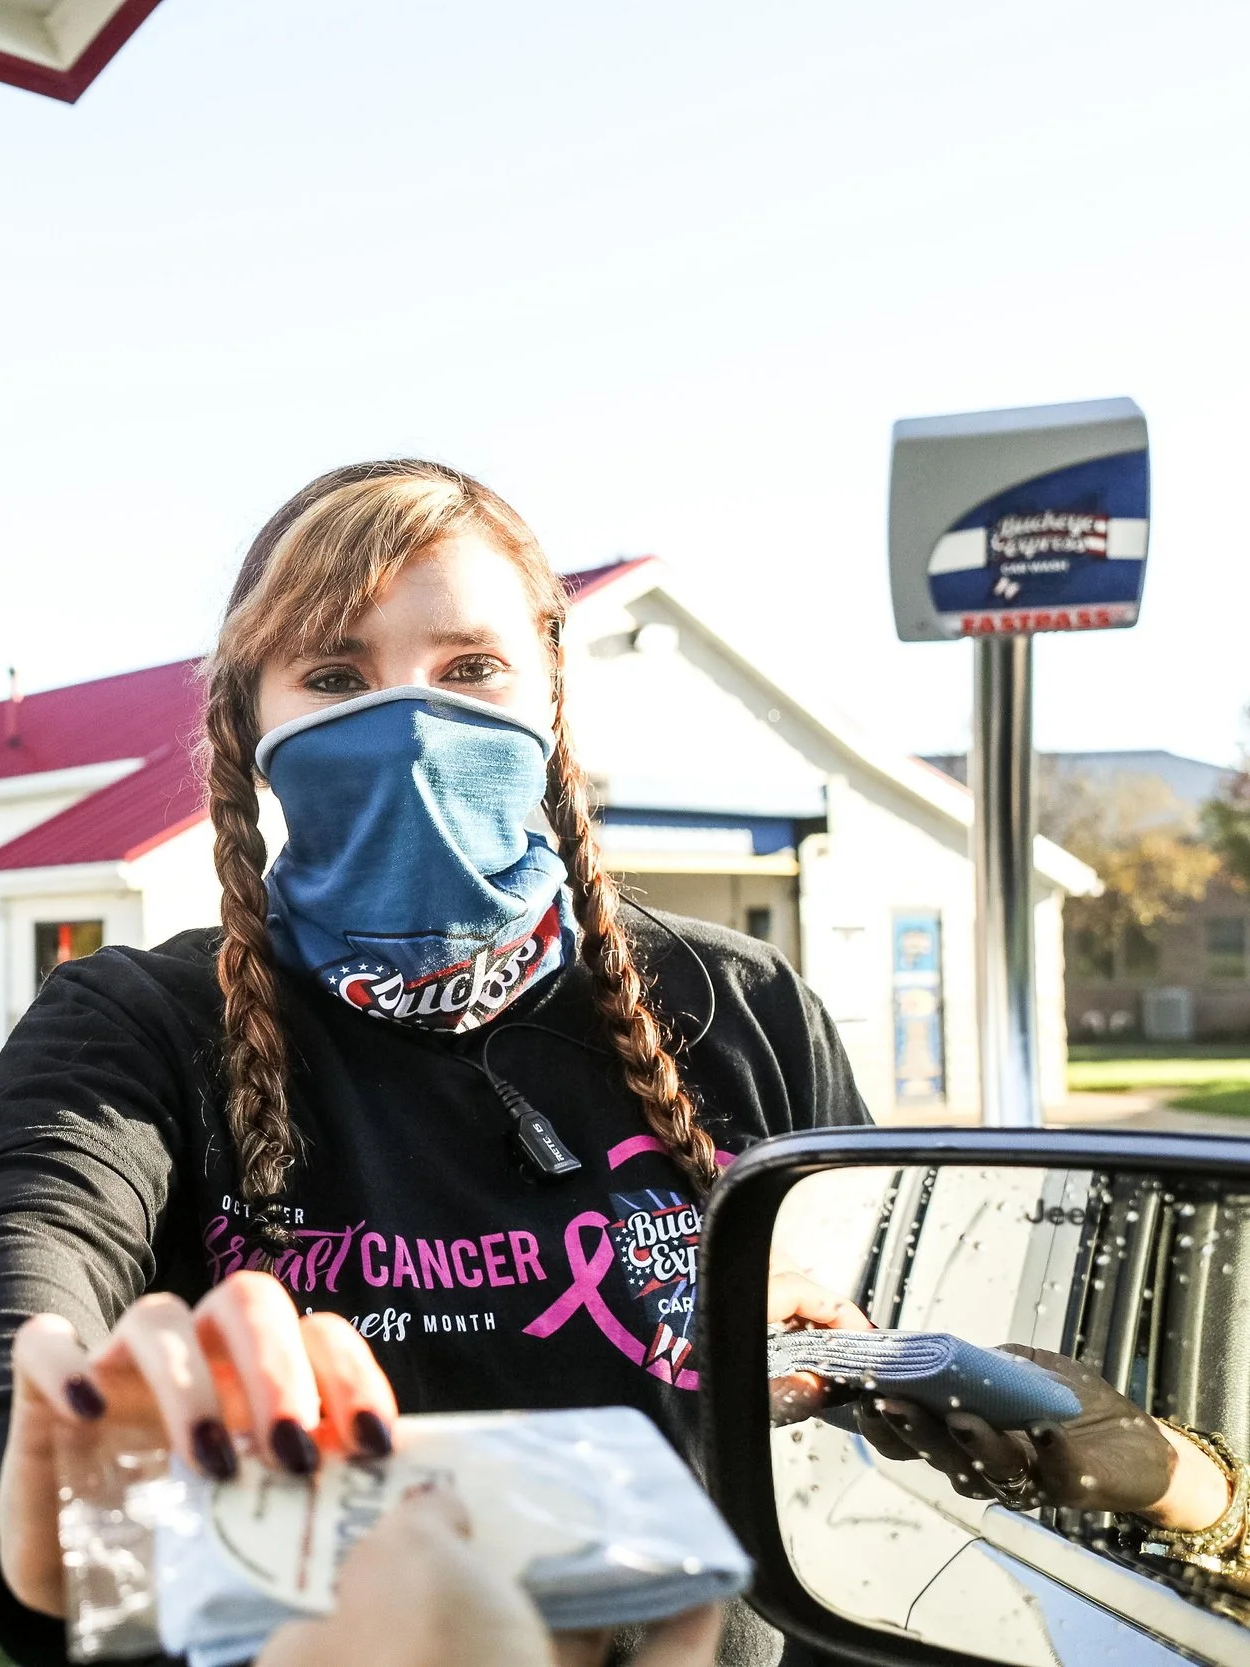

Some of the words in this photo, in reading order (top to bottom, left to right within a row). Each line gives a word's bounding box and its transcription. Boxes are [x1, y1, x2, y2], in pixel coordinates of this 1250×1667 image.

[221, 1194, 304, 1224] OCTER
[1024, 1198, 1087, 1226] Jee
[360, 1230, 547, 1289] CANCER
[657, 1296, 694, 1315] CAR
[423, 1312, 497, 1334] MONTH
